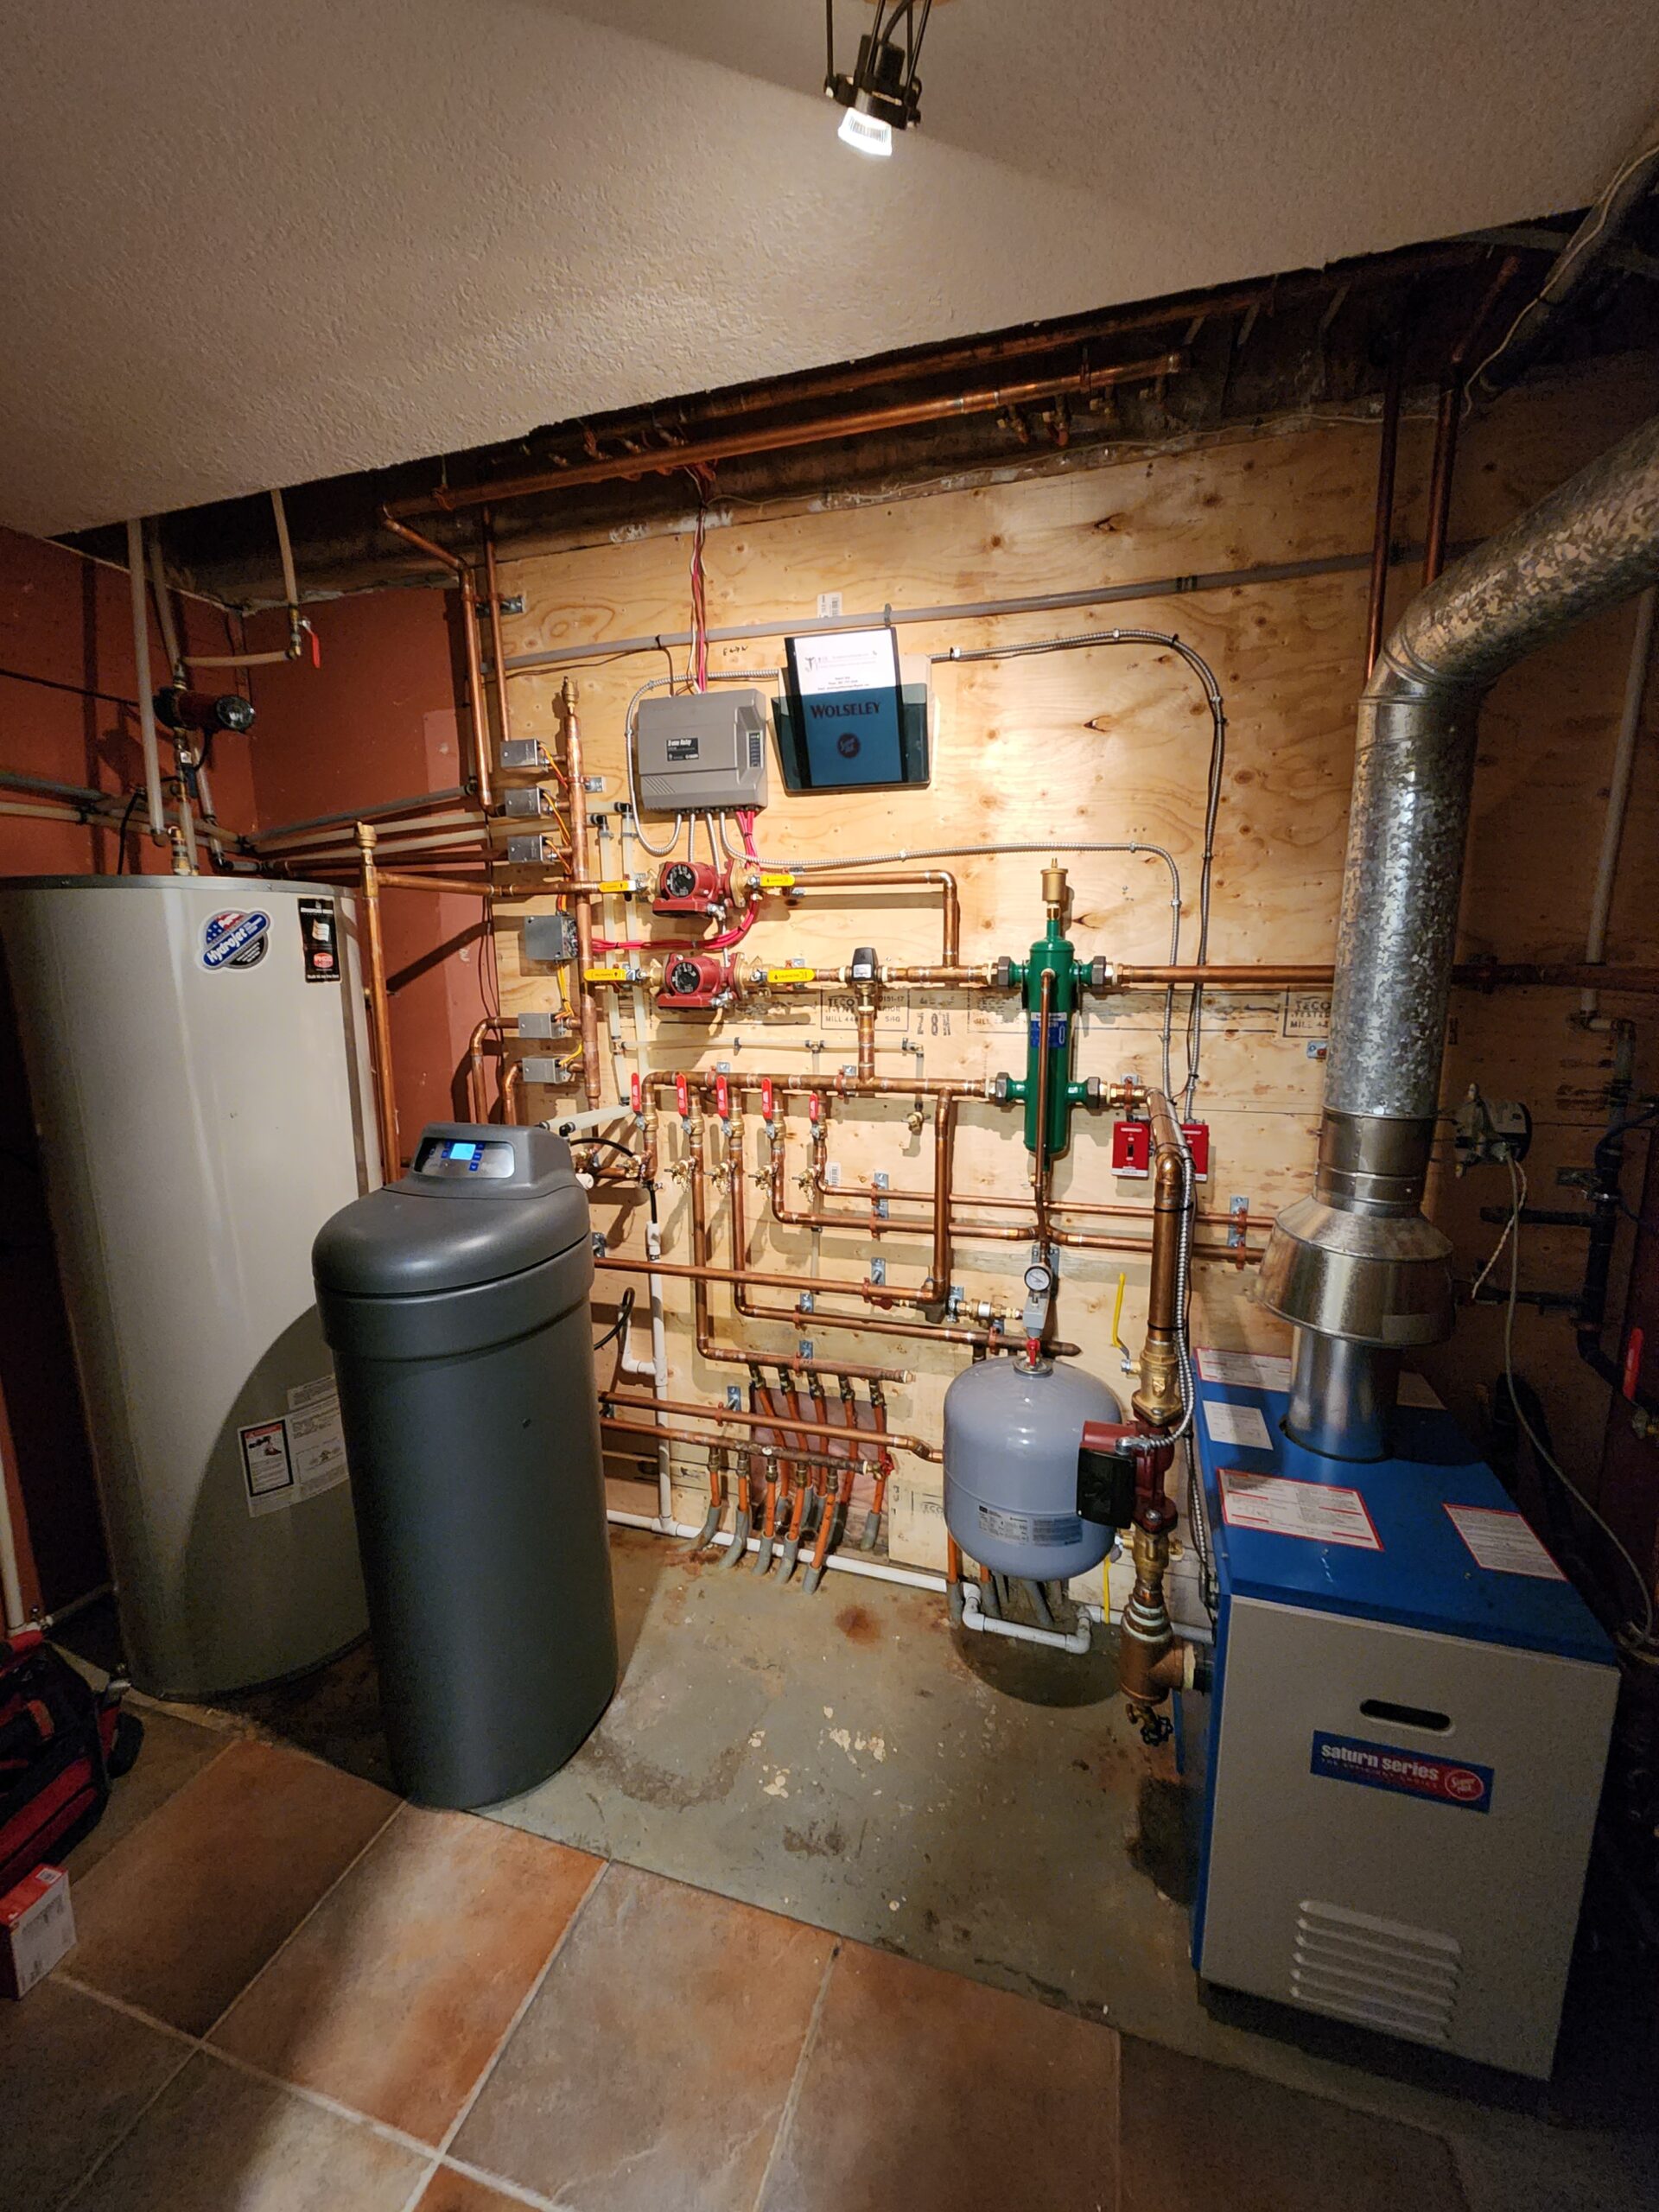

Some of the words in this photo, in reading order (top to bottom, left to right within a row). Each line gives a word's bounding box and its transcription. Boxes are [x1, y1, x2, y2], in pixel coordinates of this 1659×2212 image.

[810, 701, 881, 719] WOLSELEY
[828, 997, 855, 1007] TECO
[1320, 1744, 1379, 1768] saturn
[1382, 1758, 1440, 1781] series
